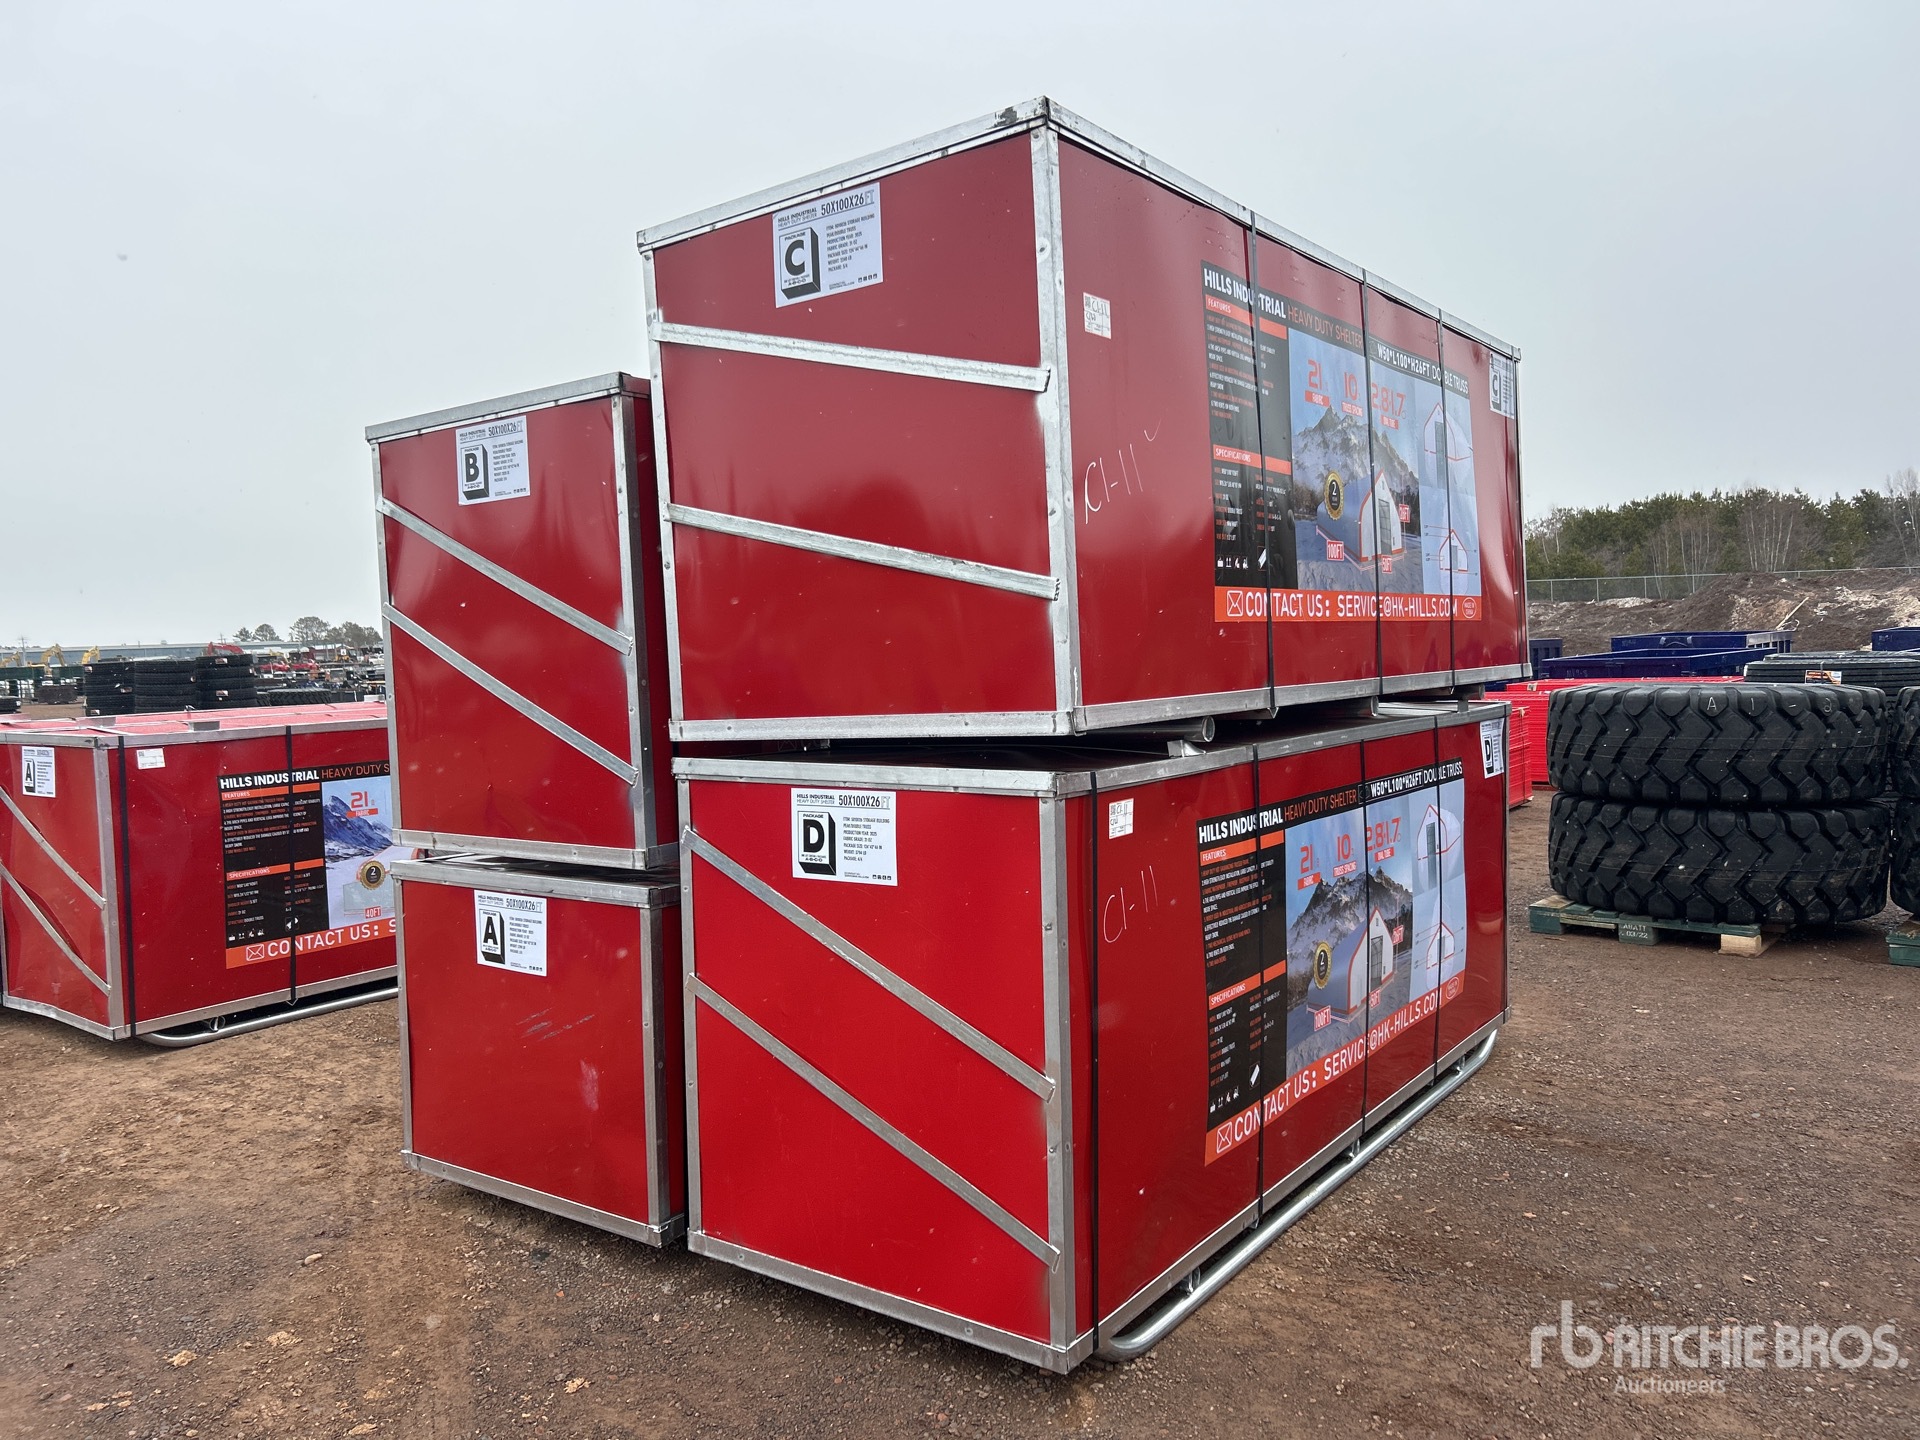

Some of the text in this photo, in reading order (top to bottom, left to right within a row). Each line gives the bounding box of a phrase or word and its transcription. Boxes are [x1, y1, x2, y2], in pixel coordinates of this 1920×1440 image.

[790, 208, 818, 220] INDUSTRIAL
[785, 240, 805, 276] C
[1204, 268, 1363, 348] HILLS INDUTRIAL HEAVY DUTY SHELTER
[1208, 298, 1231, 314] FEATURES
[1308, 359, 1322, 391] 21
[1344, 371, 1358, 401] 10
[1432, 365, 1453, 387] DOBLE
[1453, 375, 1468, 394] TRUSS
[1215, 448, 1251, 463] SPECIFICATIONS
[465, 452, 479, 482] B
[1331, 481, 1337, 496] 2
[1328, 542, 1344, 560] 100FT
[26, 762, 32, 781] A
[220, 776, 253, 790] HILLS
[322, 766, 353, 779] HEAVY
[356, 764, 380, 776] DUTY
[1447, 761, 1462, 777] TRUSS
[224, 791, 250, 799] FEATURES
[351, 791, 369, 808] 21
[1199, 821, 1228, 844] HILLS
[1284, 802, 1307, 822] HEAVY
[1308, 797, 1328, 815] DUTY
[1330, 789, 1357, 808] SHELTER
[803, 819, 825, 853] D
[1202, 850, 1226, 861] FEATURES
[1300, 844, 1313, 874] 21
[1337, 834, 1350, 862] 10
[229, 867, 270, 879] SPECIFICATIONS
[370, 867, 376, 876] 2
[365, 907, 381, 918] 40FT
[1104, 865, 1158, 943] C1-11
[483, 916, 498, 945] A
[1211, 983, 1246, 1005] SPECIFICATIONS
[1315, 1008, 1331, 1029] 100FT
[1234, 1082, 1290, 1142] CONTACT
